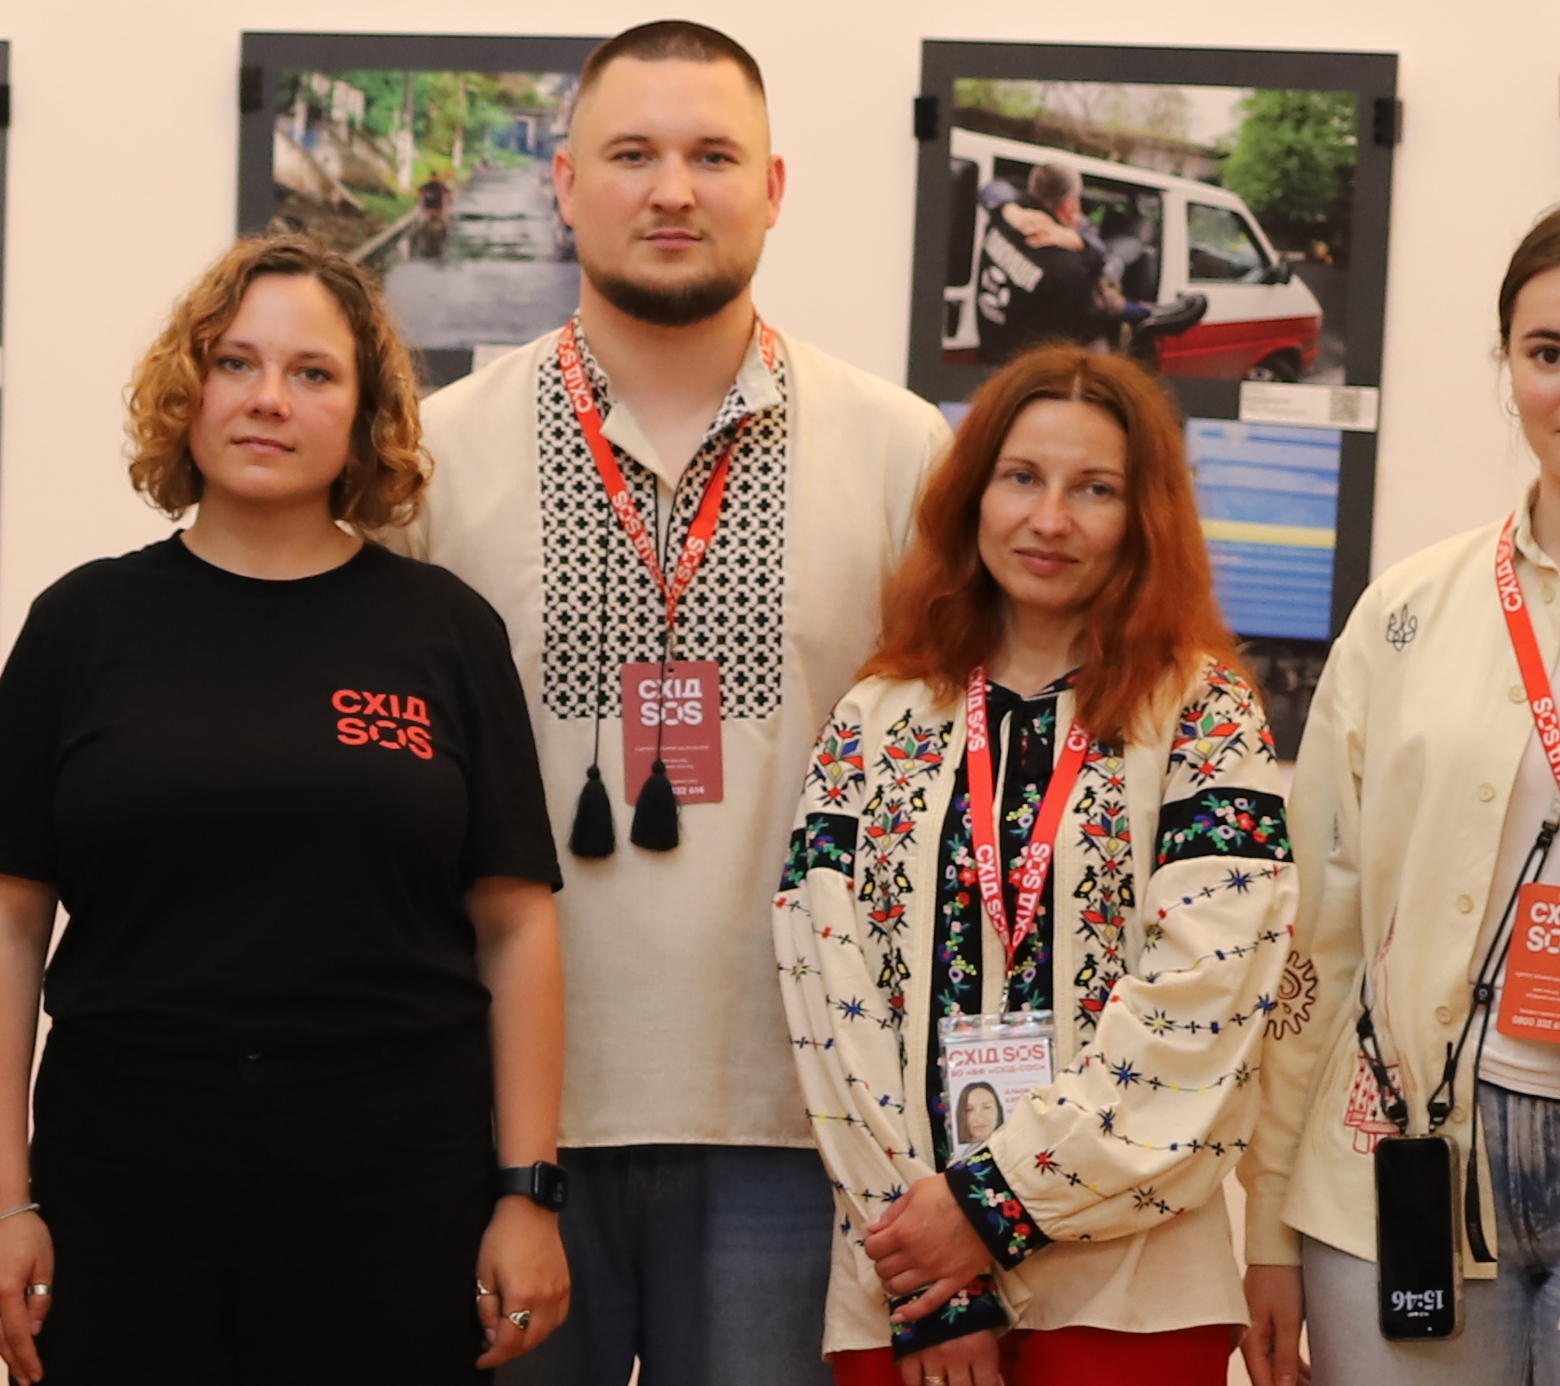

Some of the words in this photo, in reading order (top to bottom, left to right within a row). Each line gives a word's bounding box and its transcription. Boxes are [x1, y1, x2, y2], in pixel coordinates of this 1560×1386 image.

[564, 365, 593, 413] СХІД
[612, 491, 641, 534] SOS
[677, 536, 706, 582] SOS
[1497, 560, 1523, 612] СХІД
[331, 689, 430, 726] СХІД
[637, 678, 703, 699] СХІД
[640, 700, 703, 726] SOS
[968, 710, 987, 752] SOS
[1533, 697, 1560, 746] SOS
[337, 717, 434, 760] SOS
[976, 844, 1001, 899] СХІД
[1022, 842, 1051, 890] SOS
[1012, 893, 1037, 948] СХІД
[949, 1047, 1000, 1066] СХІД
[1002, 1044, 1046, 1062] SOS
[1391, 1289, 1444, 1311] 15:46
